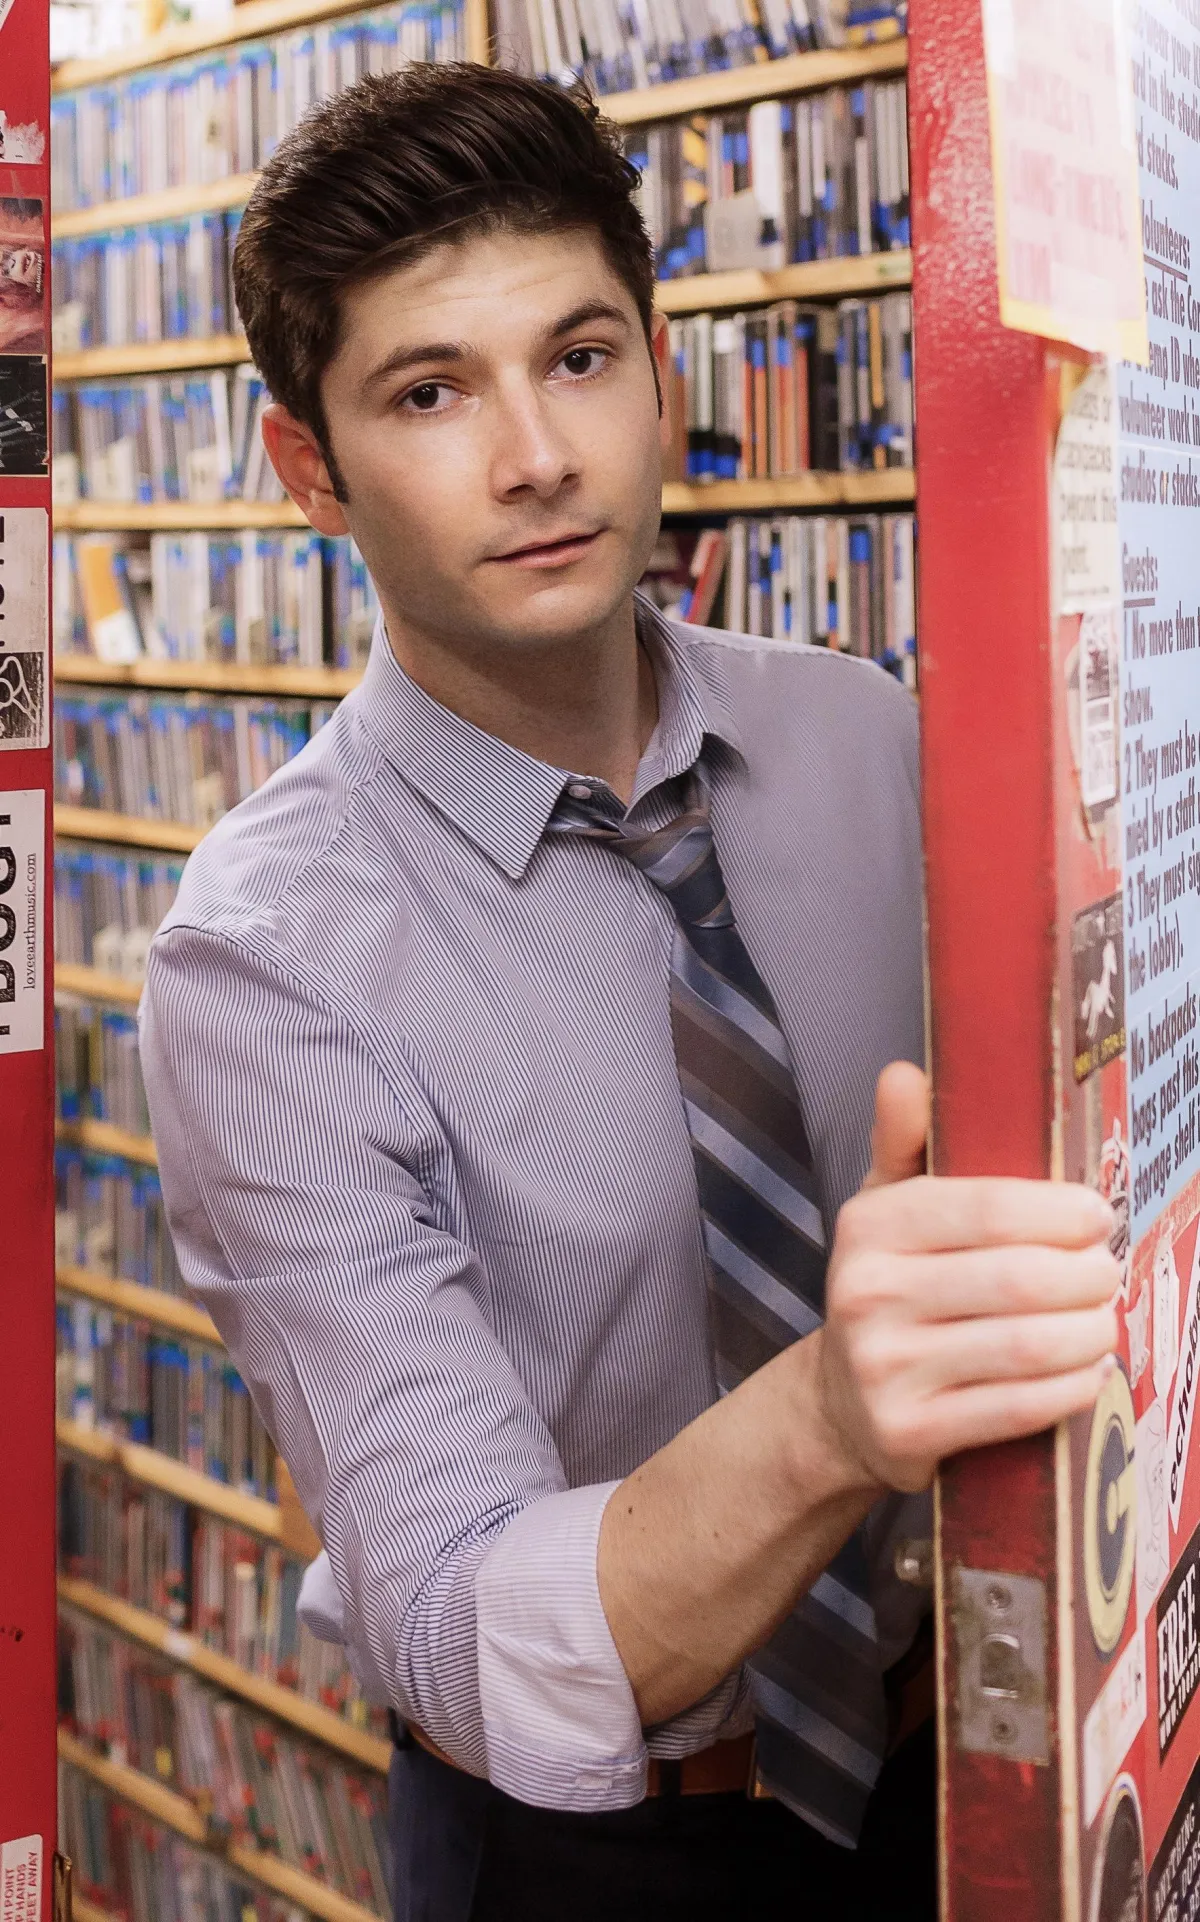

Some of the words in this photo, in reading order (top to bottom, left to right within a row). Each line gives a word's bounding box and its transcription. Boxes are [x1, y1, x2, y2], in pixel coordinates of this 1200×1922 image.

[1171, 34, 1191, 80] your
[1148, 56, 1158, 113] in
[1160, 69, 1175, 126] the
[1177, 92, 1200, 144] studi
[1147, 133, 1179, 191] stacks.
[1152, 268, 1169, 321] ask
[1170, 276, 1186, 327] the
[1146, 341, 1168, 390] emp
[1170, 336, 1180, 383] ID
[1118, 380, 1166, 440] volunteer
[1168, 395, 1191, 445] work
[1121, 449, 1156, 505] studios
[1160, 470, 1169, 506] or
[1122, 541, 1158, 594] Guests:
[1133, 609, 1146, 660] No
[1149, 618, 1173, 657] more
[1176, 600, 1196, 652] than
[1124, 672, 1154, 728] show.
[1125, 742, 1131, 794] 2
[1135, 733, 1158, 795] They
[1161, 729, 1183, 780] must
[1185, 719, 1196, 770] be
[1151, 794, 1164, 857] by
[1167, 804, 1173, 841] a
[1175, 776, 1195, 837] staff
[1128, 875, 1135, 929] 3
[1137, 864, 1161, 924] They
[1163, 851, 1185, 906] must
[23, 852, 37, 991] loveearthmusic.com
[1129, 936, 1146, 995] the
[1149, 909, 1184, 981] lobby).
[1131, 1028, 1145, 1082] No
[1149, 982, 1197, 1068] backpacks
[1131, 1093, 1157, 1149] bags
[1160, 1060, 1181, 1134] past
[1183, 1038, 1199, 1098] this
[1134, 1142, 1171, 1217] storage
[1174, 1097, 1195, 1171] shelf
[1158, 1562, 1197, 1720] FREE
[4, 1868, 15, 1908] POINT
[15, 1864, 27, 1911] HANDS
[28, 1851, 37, 1887] AWAY
